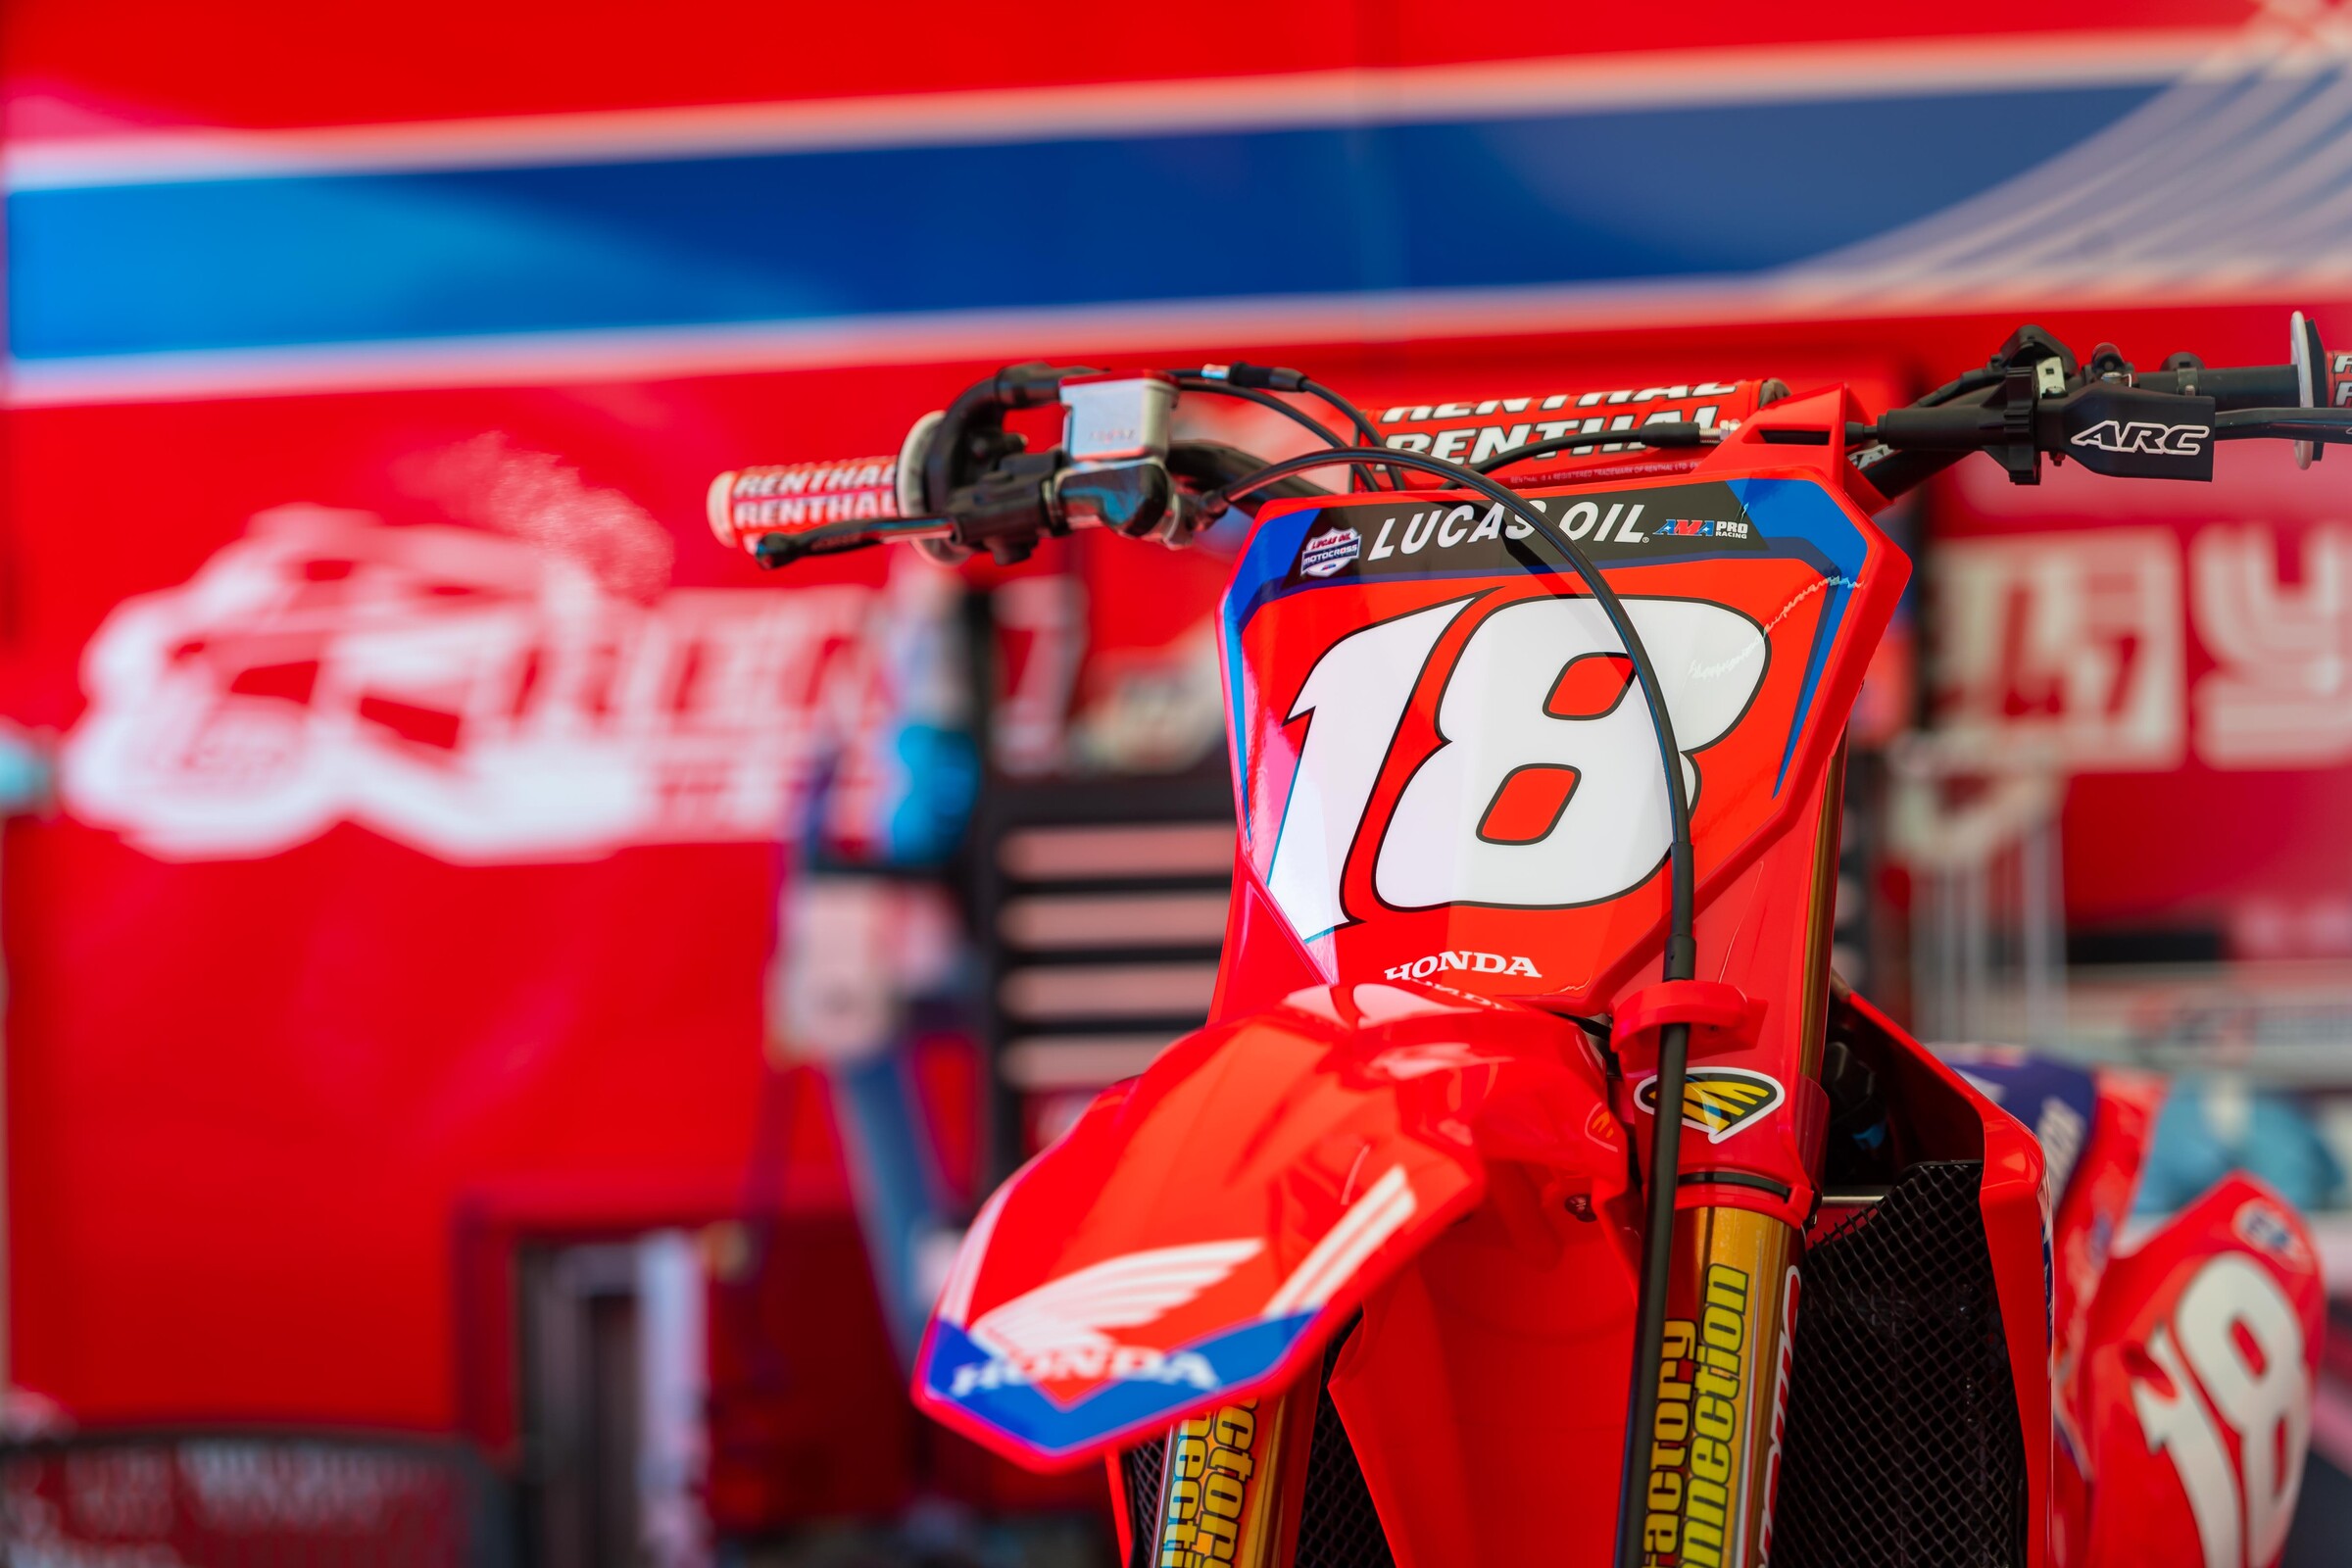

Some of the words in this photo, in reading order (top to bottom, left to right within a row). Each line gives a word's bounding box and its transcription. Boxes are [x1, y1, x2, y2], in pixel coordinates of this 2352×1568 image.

[2071, 419, 2210, 456] ARC
[735, 490, 897, 529] RENTHAL
[1652, 519, 1715, 537] AMA
[1716, 520, 1748, 534] PRO
[1311, 536, 1338, 550] LUCAS
[1367, 500, 1547, 562] LUCAS
[1715, 530, 1747, 539] RACING
[1303, 543, 1358, 565] MOTOCROSS
[1282, 585, 1771, 944] 18
[1384, 951, 1543, 981] HONDA
[1681, 1262, 1749, 1568] nnection
[2132, 1250, 2313, 1568] 18
[1642, 1318, 1698, 1568] actory
[1200, 1397, 1260, 1568] ctor
